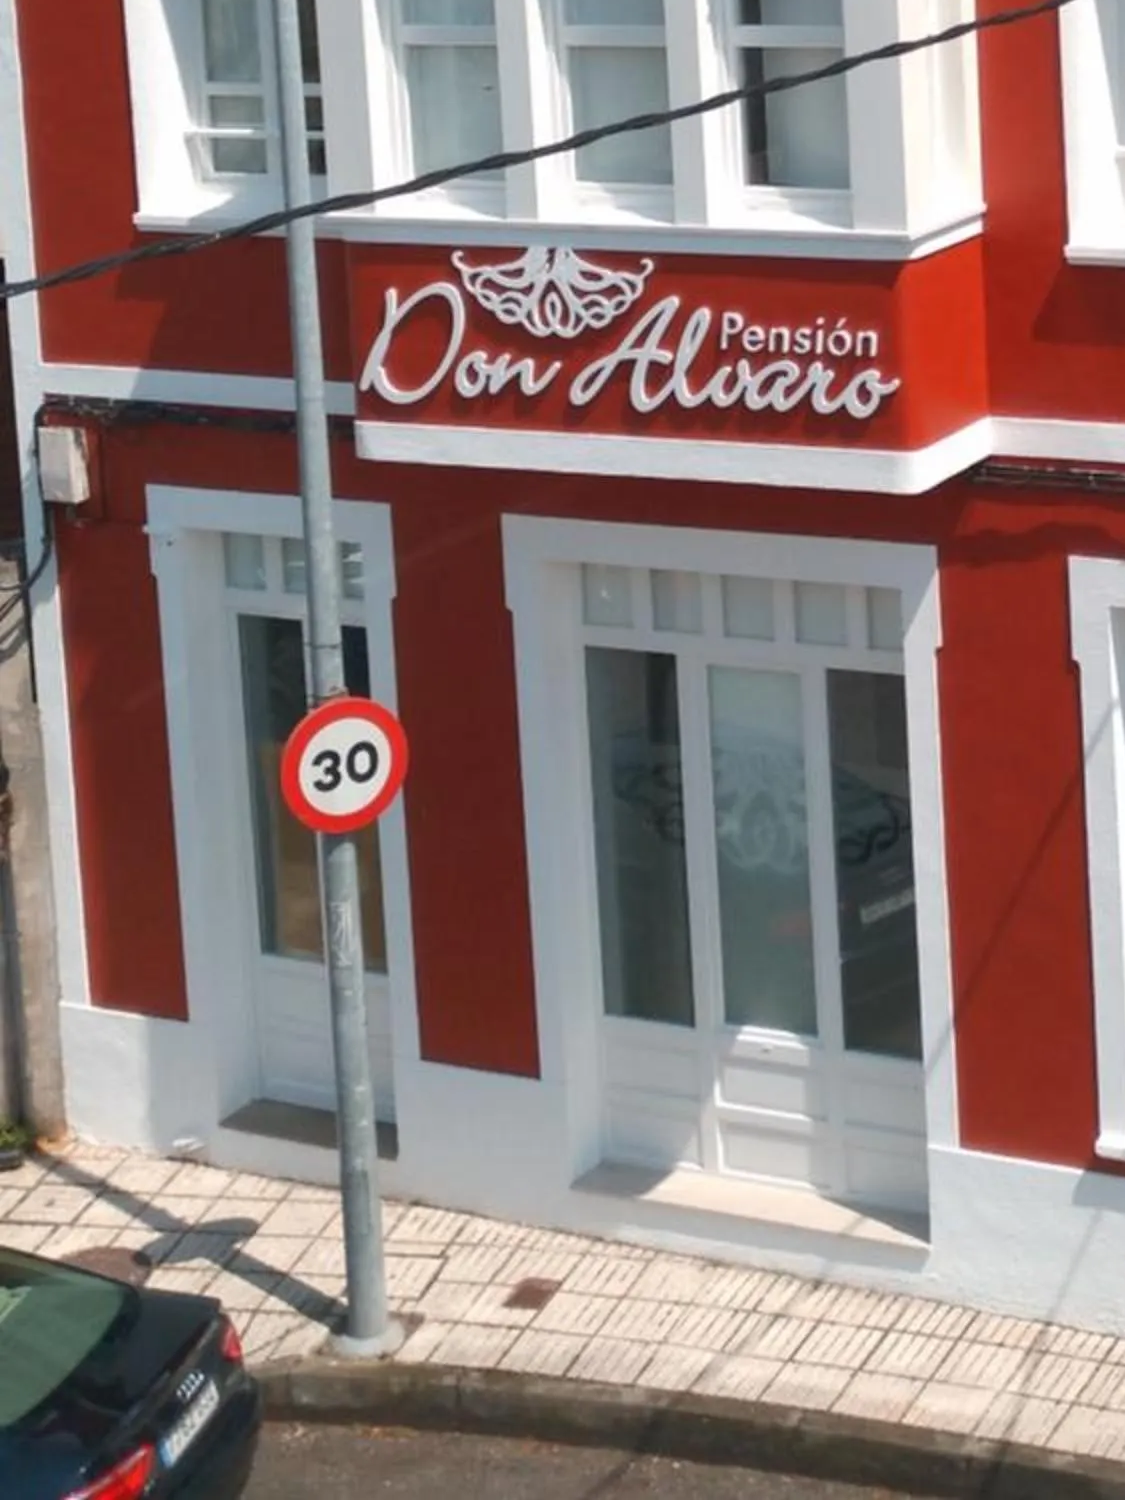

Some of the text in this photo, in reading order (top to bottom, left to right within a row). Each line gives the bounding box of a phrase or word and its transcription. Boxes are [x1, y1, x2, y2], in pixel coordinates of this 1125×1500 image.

[360, 282, 901, 419] Don Alvaro
[720, 311, 879, 357] Pensión
[311, 741, 379, 792] 30
